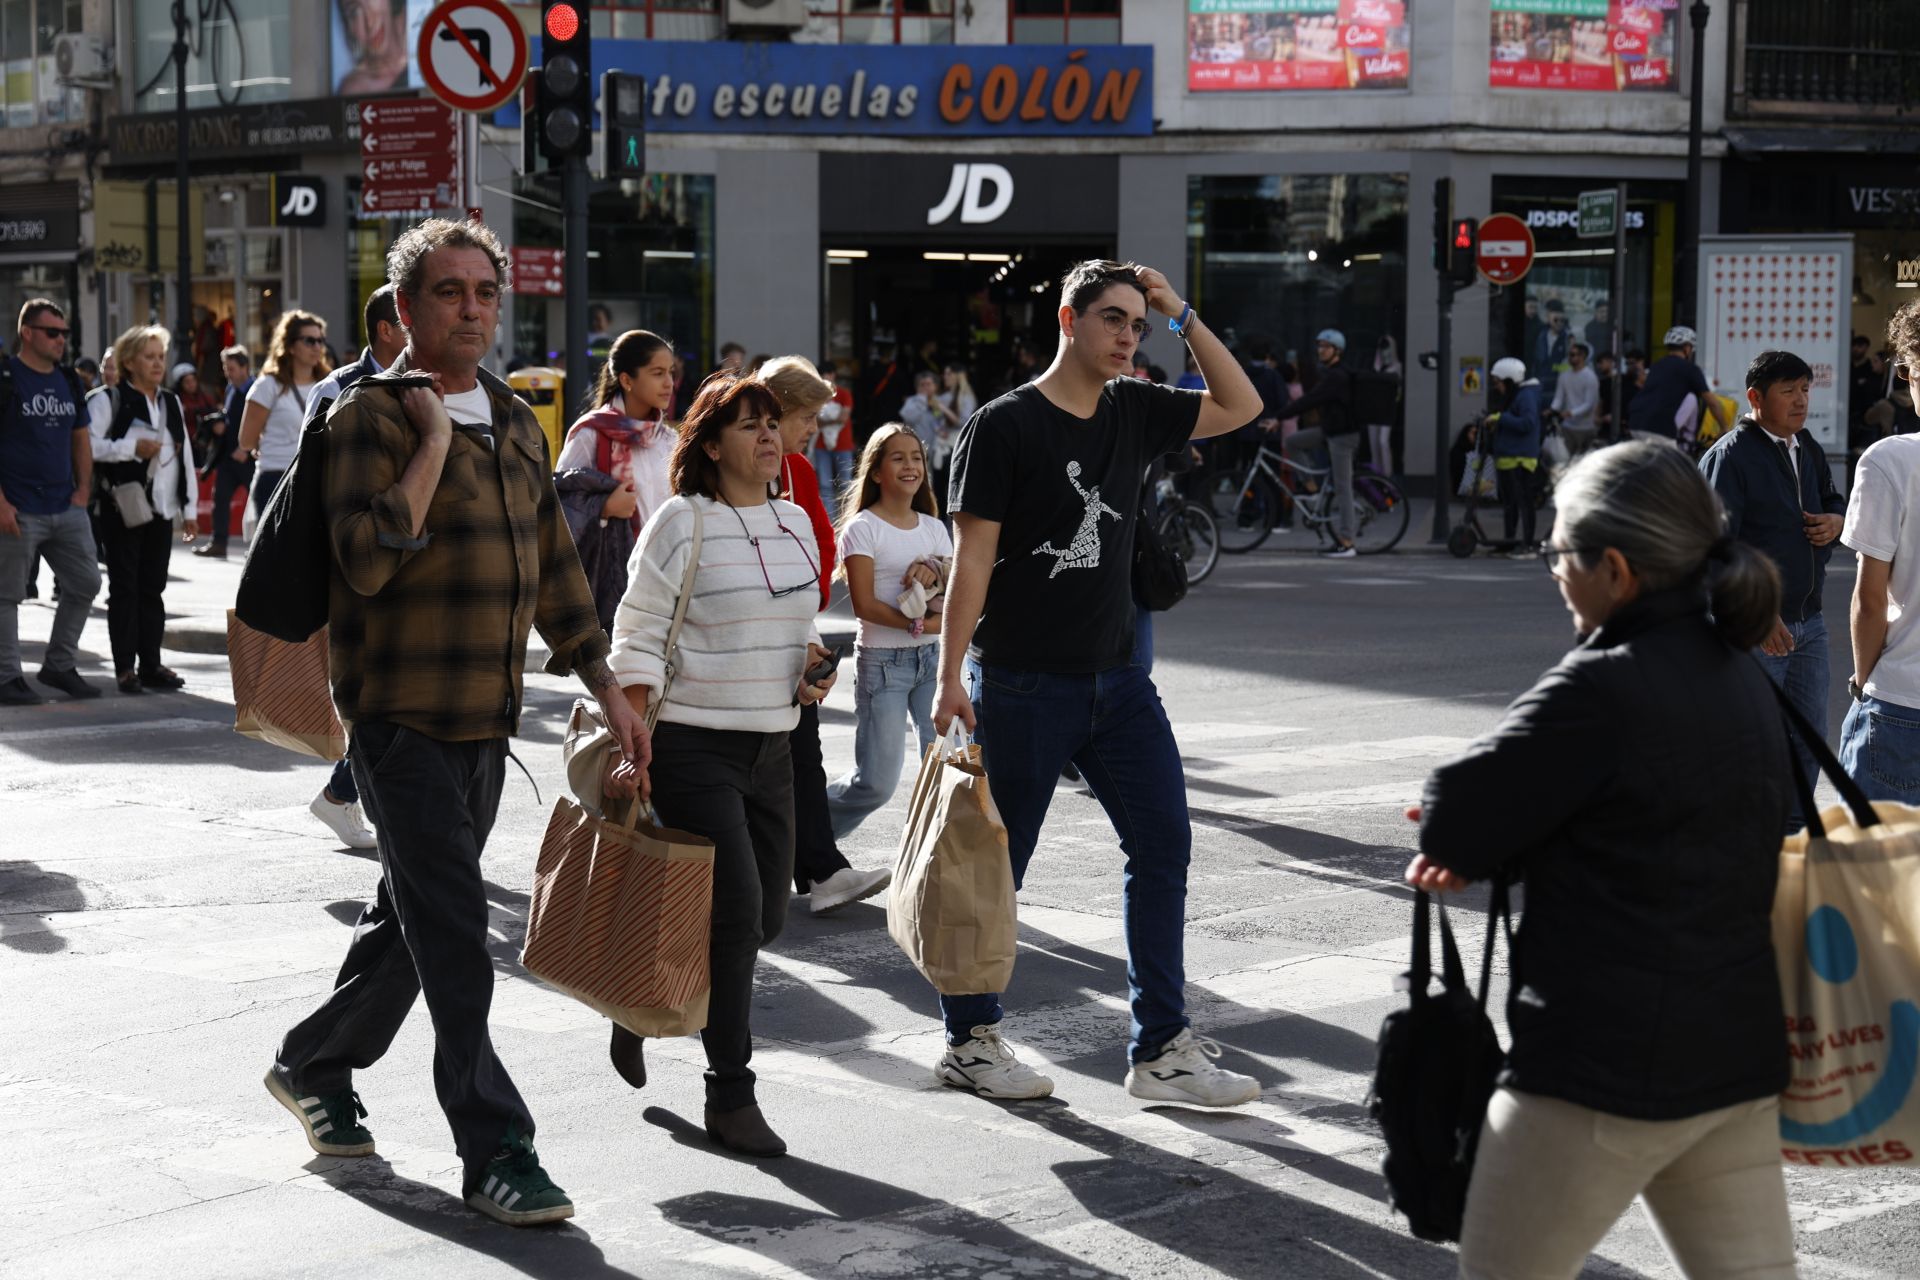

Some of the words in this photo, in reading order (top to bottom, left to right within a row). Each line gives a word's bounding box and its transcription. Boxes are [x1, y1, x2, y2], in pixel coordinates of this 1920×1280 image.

[713, 69, 919, 119] escuelas
[939, 49, 1142, 122] COLÓN
[281, 186, 318, 216] JD
[928, 163, 1014, 225] JD
[1827, 1023, 1885, 1049] LIVES
